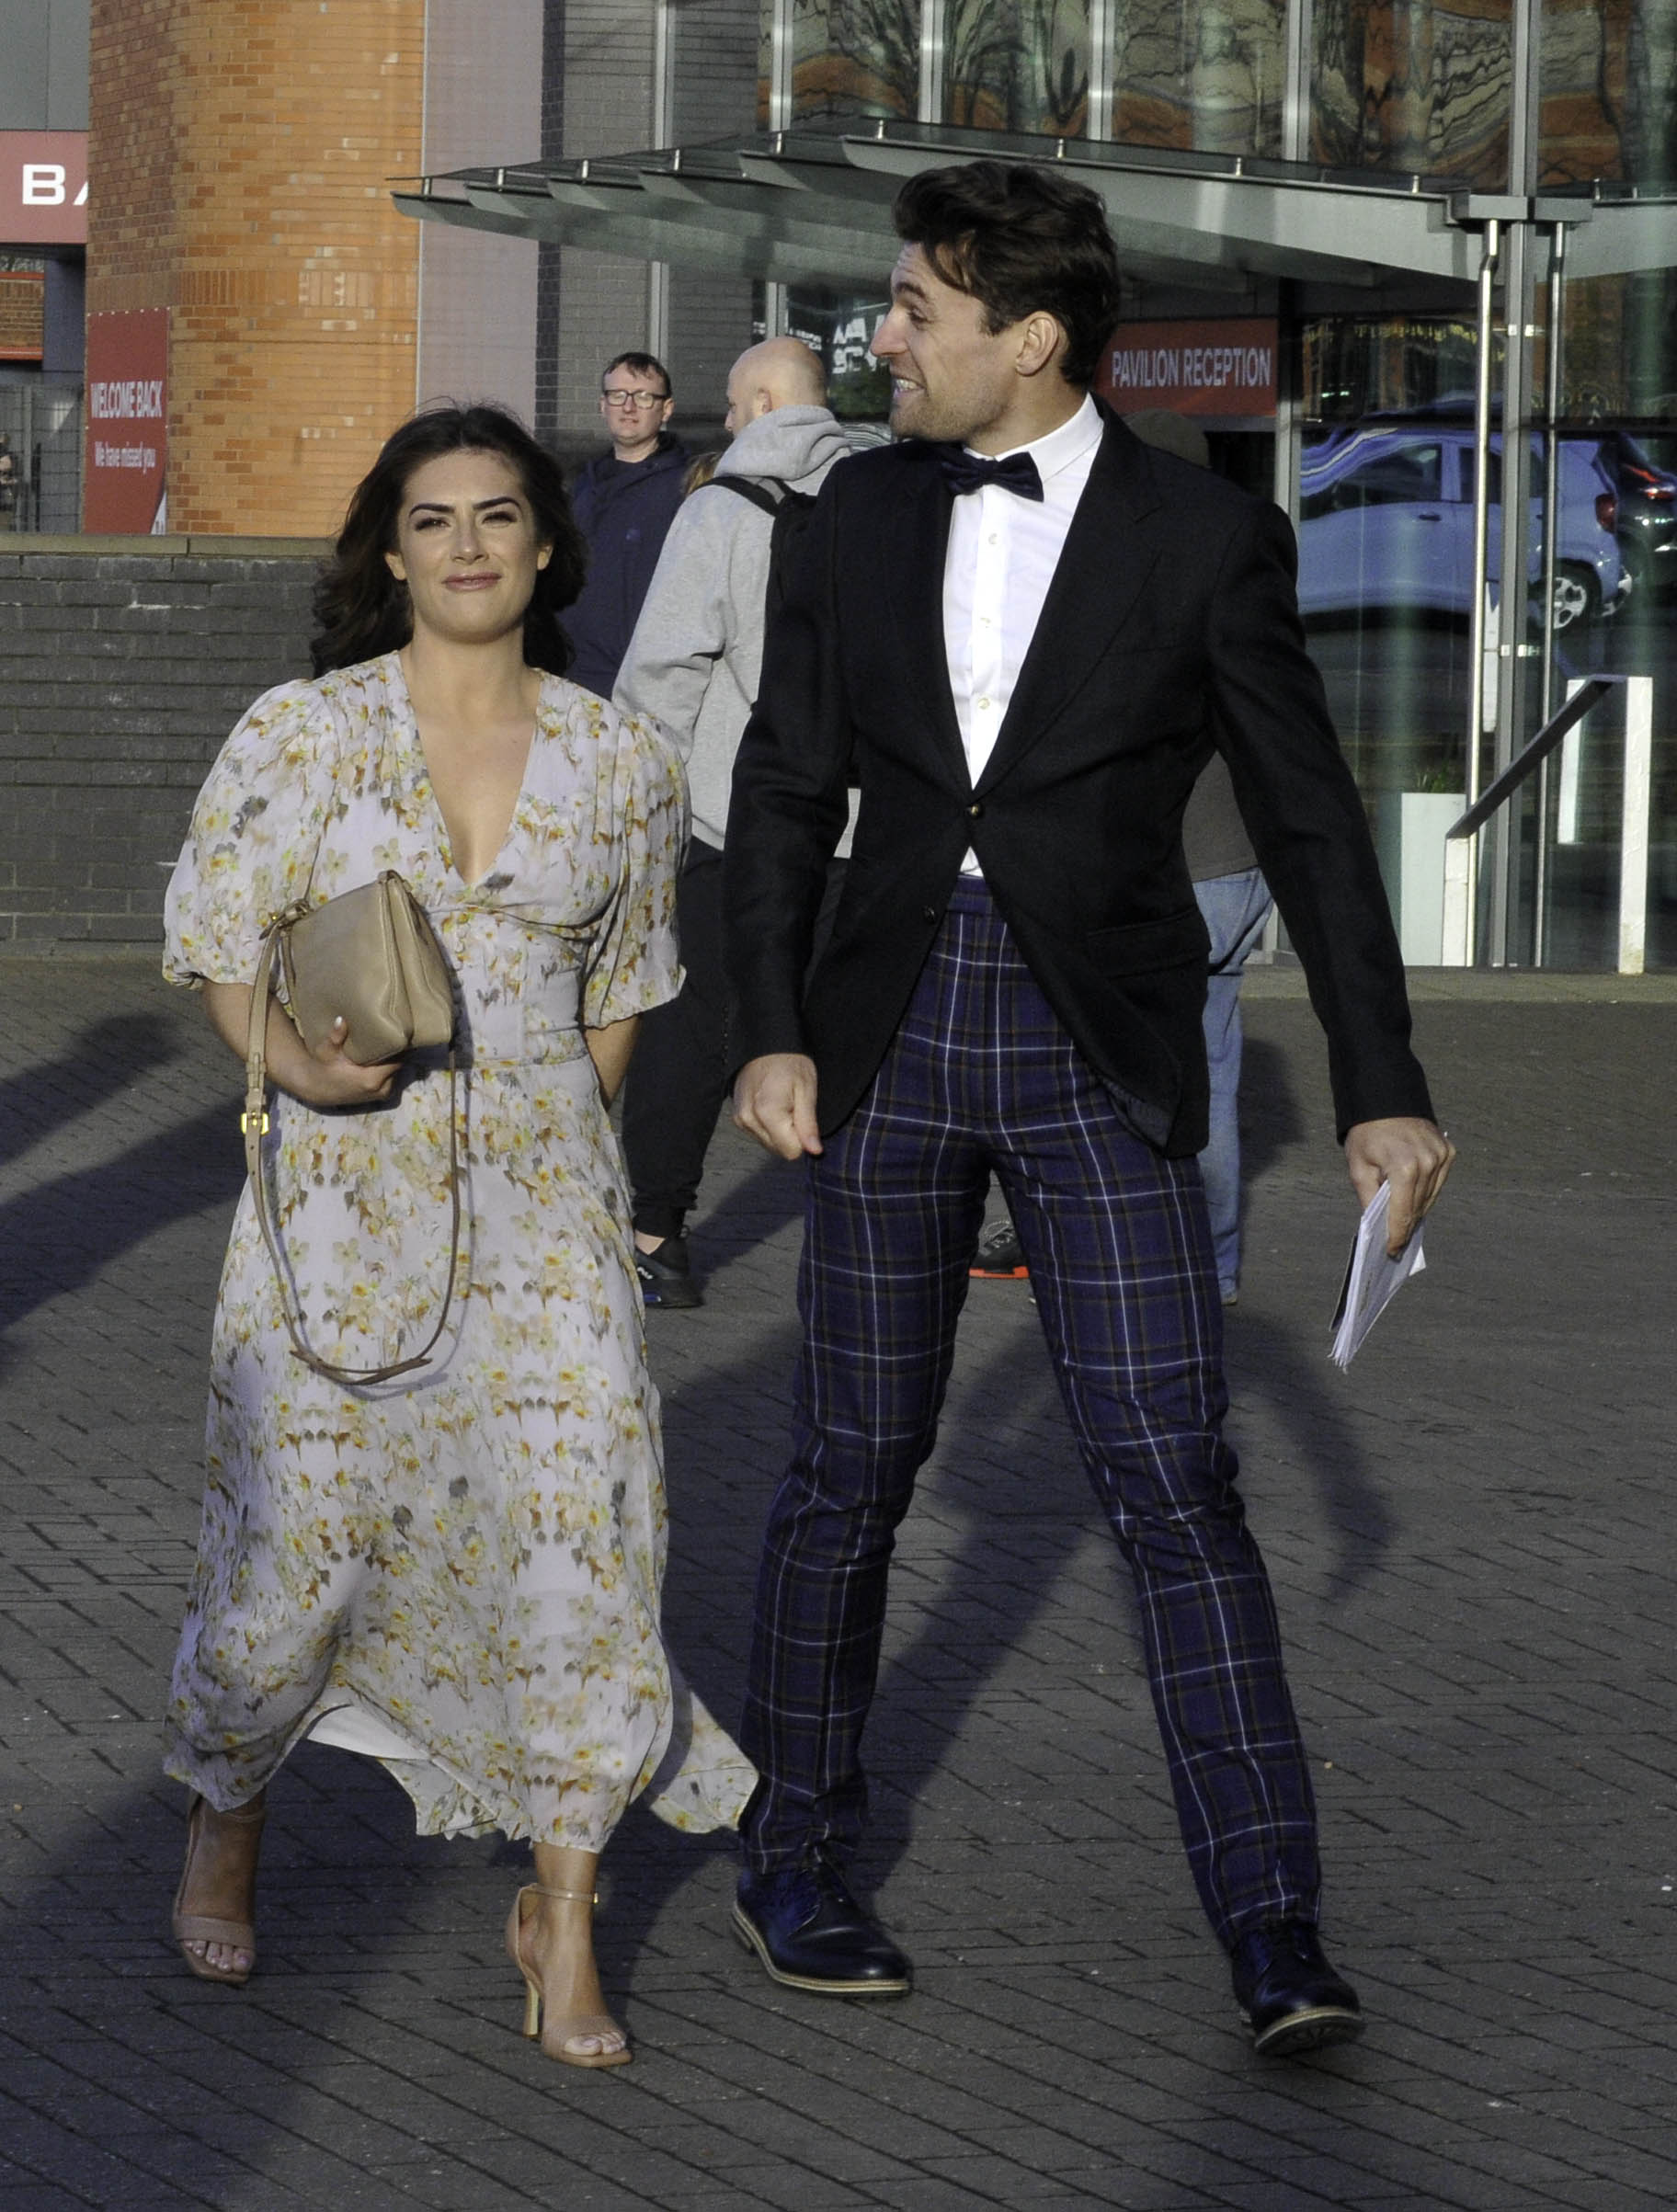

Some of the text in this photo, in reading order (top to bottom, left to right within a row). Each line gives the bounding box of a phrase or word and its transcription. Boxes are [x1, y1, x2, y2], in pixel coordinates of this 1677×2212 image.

[1112, 347, 1272, 387] PAVILION RECEPTION
[90, 380, 163, 418] WELCOME BACK
